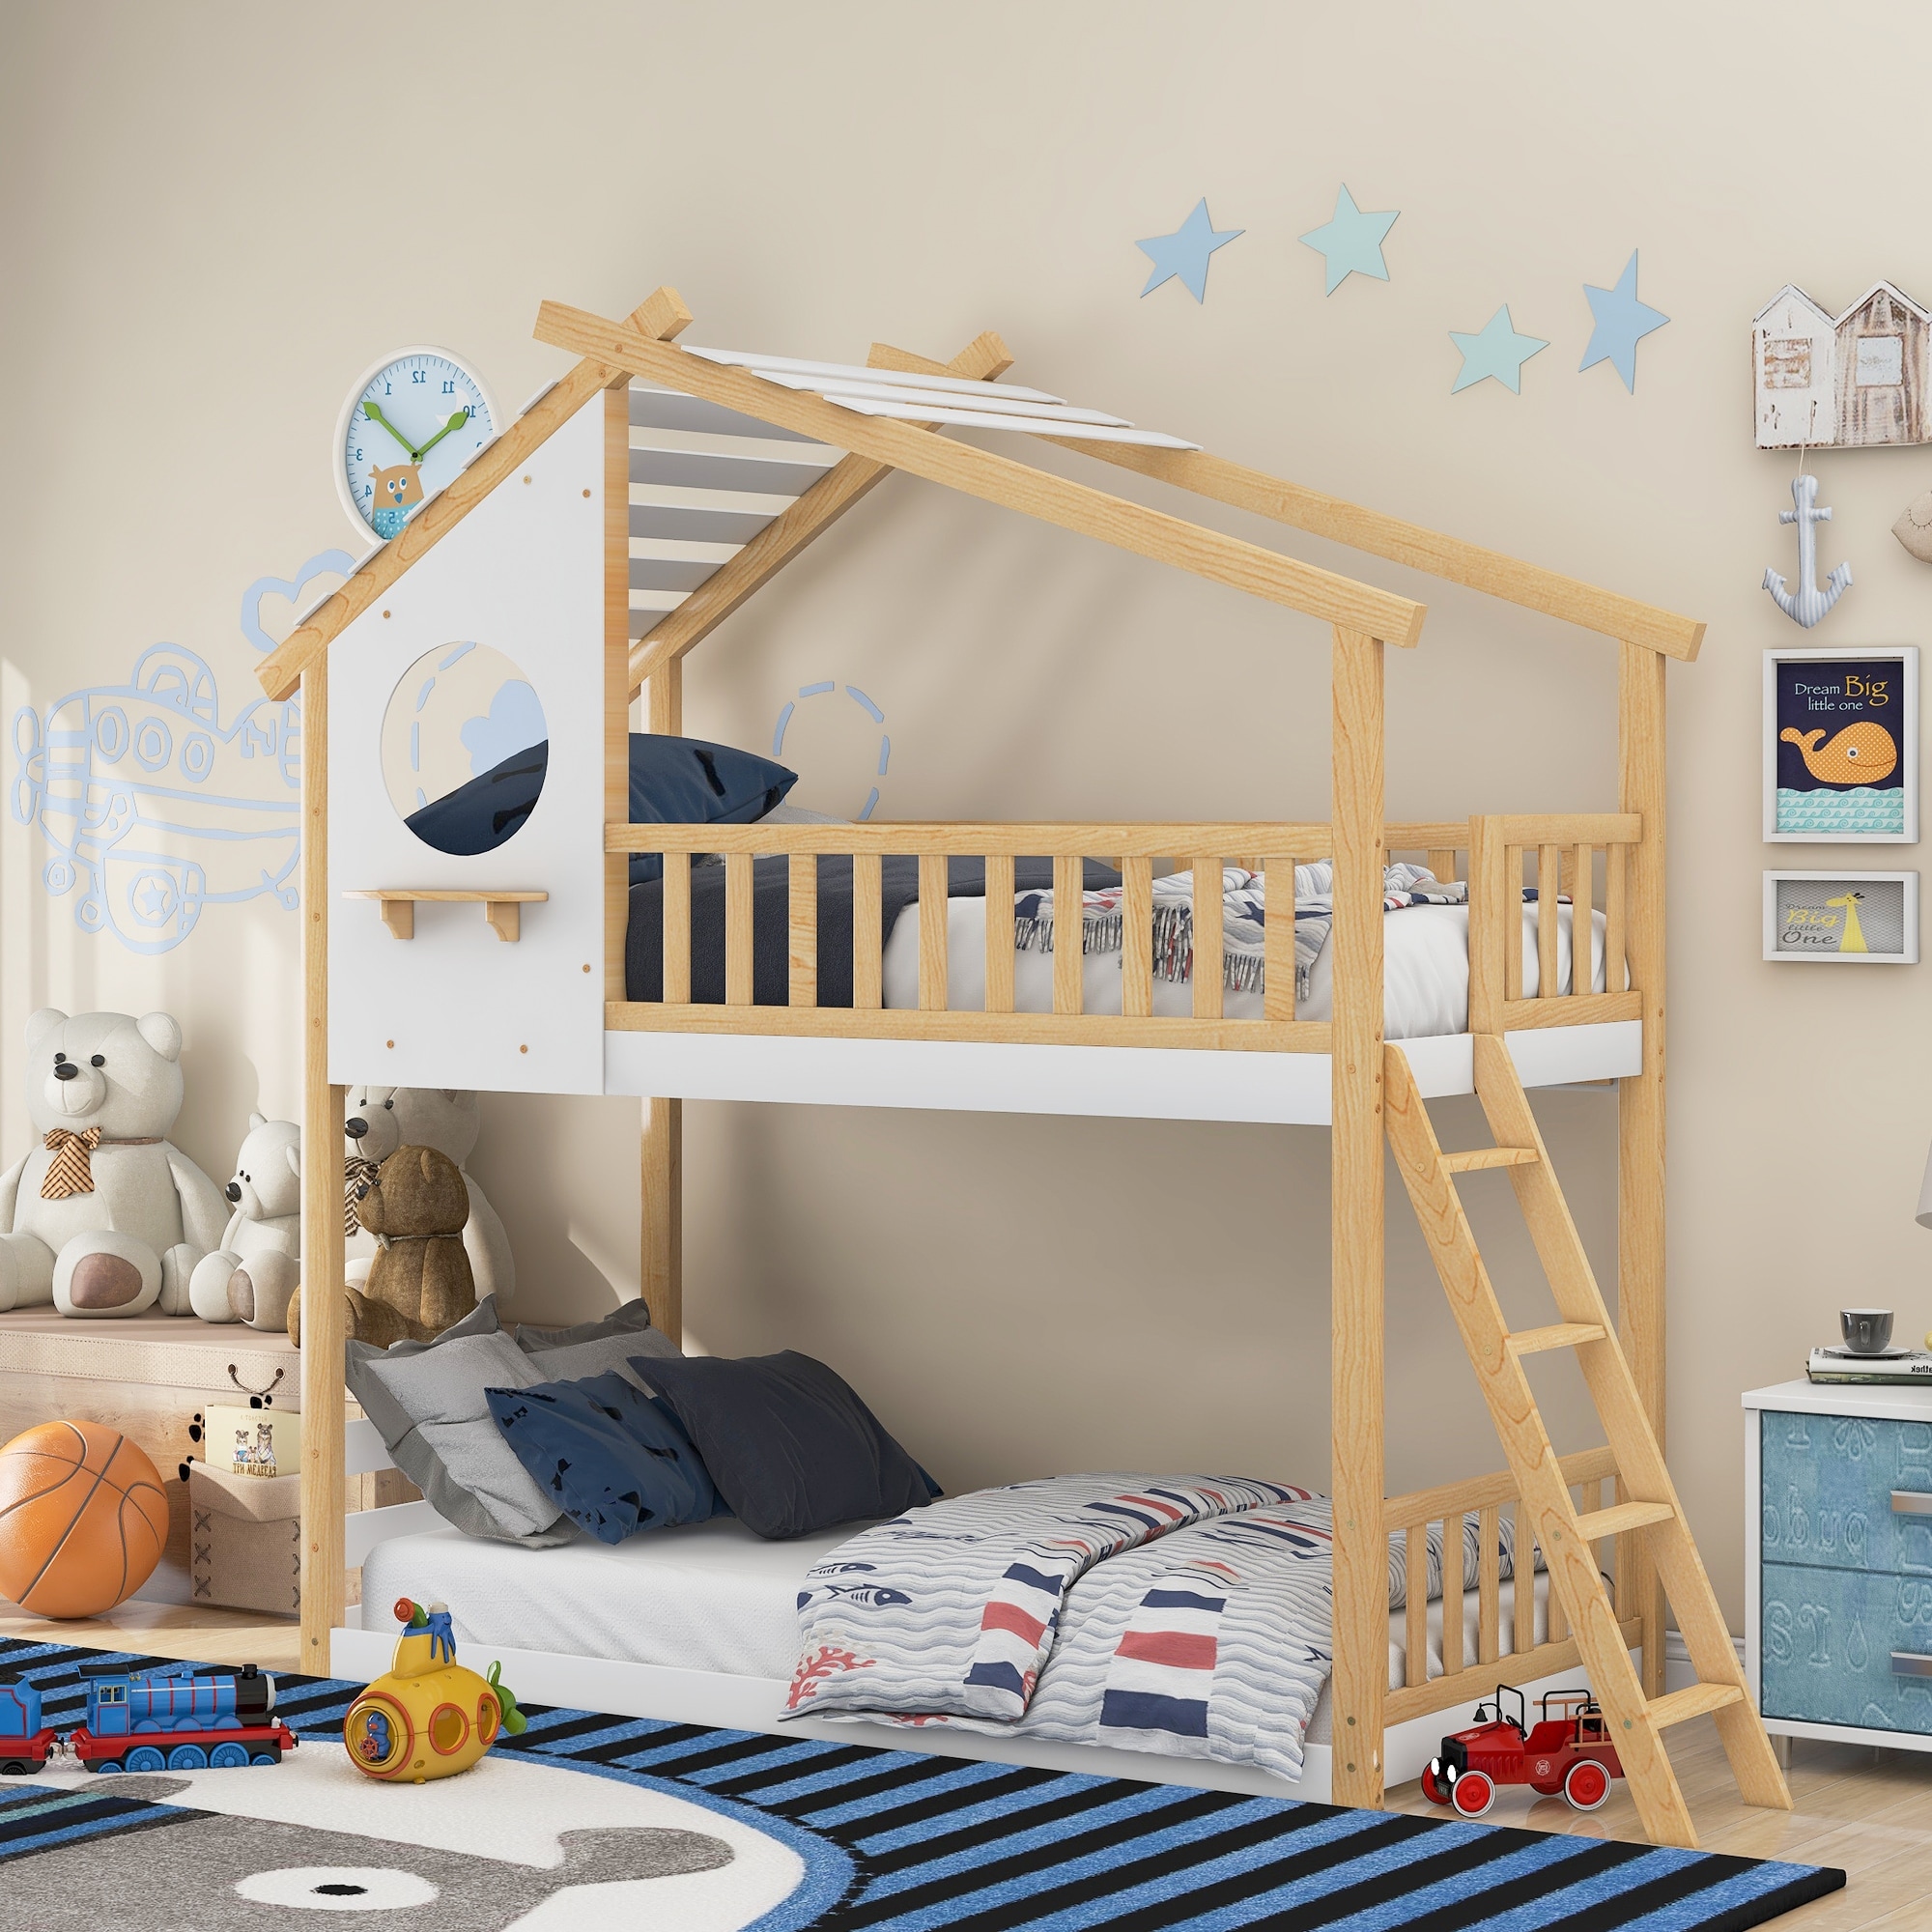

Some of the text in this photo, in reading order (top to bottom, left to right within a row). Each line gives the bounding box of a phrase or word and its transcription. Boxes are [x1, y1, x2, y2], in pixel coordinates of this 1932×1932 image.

[1795, 674, 1889, 706] Dream Big
[1808, 696, 1863, 711] little one
[1786, 909, 1840, 927] Big
[1782, 930, 1837, 944] One
